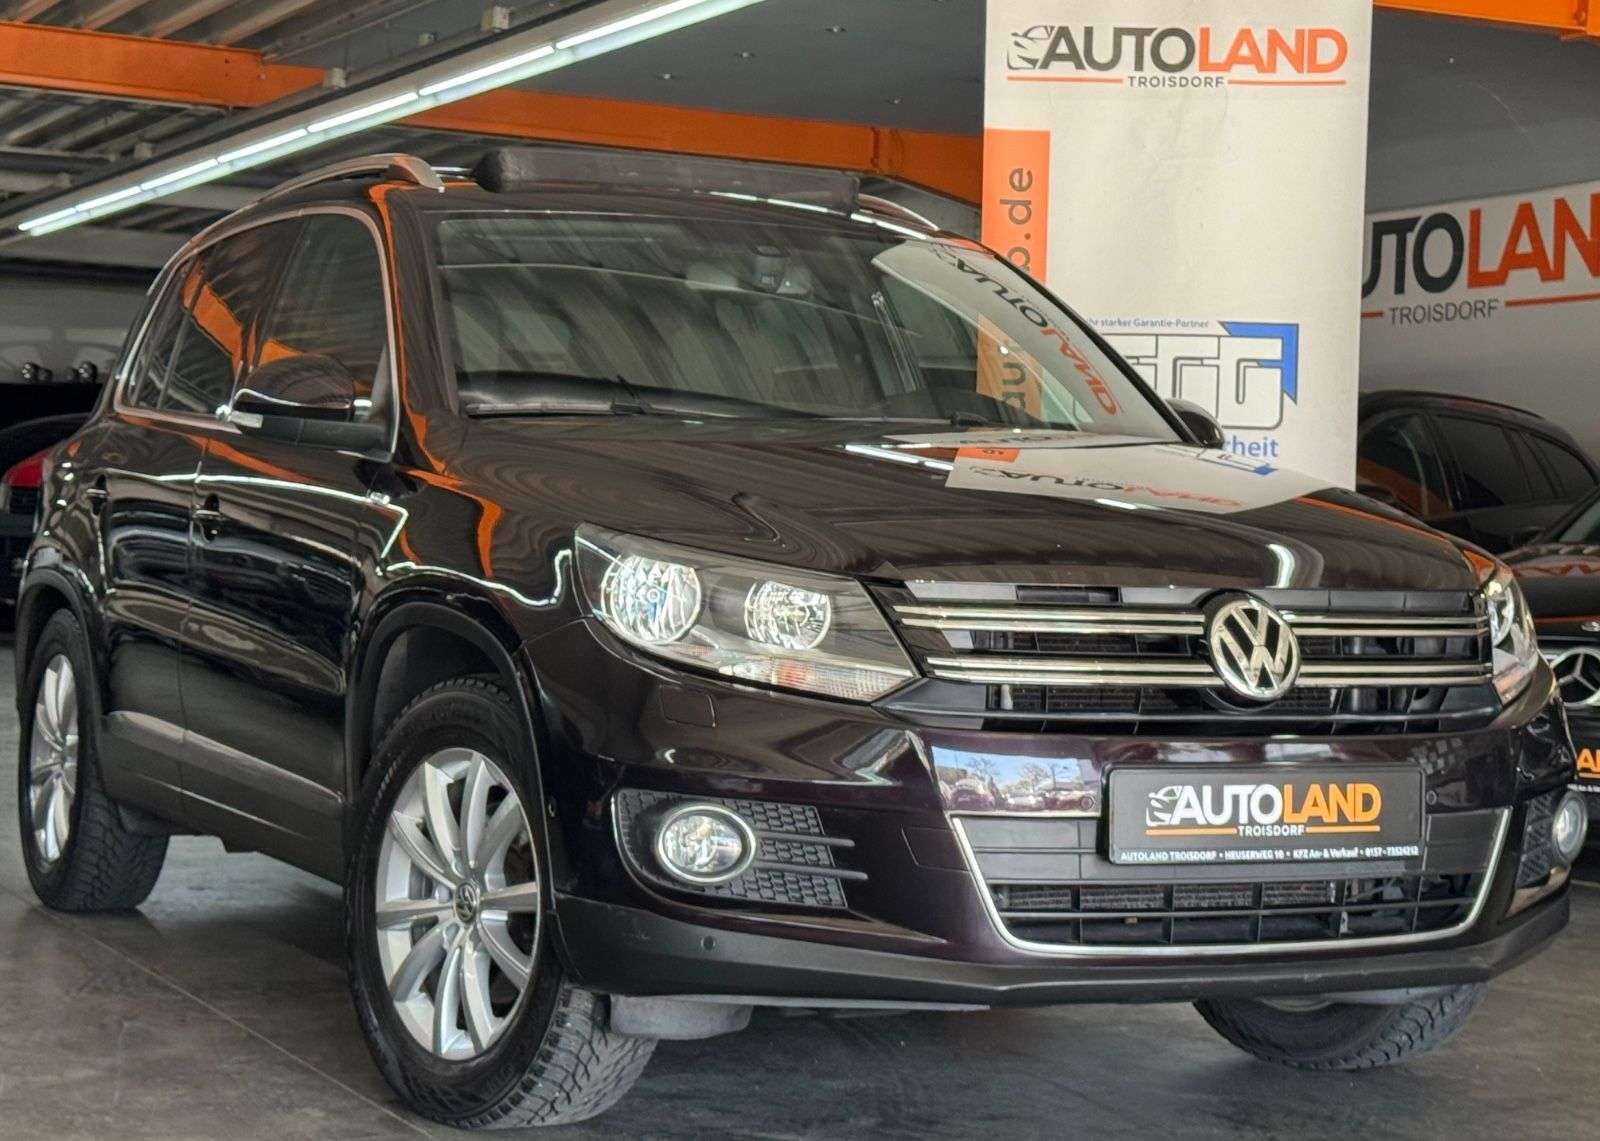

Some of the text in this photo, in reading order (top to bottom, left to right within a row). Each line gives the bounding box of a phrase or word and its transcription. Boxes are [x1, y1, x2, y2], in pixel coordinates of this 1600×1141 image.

[1040, 26, 1348, 74] AUTOLAND
[1127, 75, 1224, 89] TROISDORF
[1388, 297, 1499, 326] TROISDORF
[1170, 783, 1382, 826] AUTOLAND
[1237, 825, 1306, 837] TROISDORF
[1120, 851, 1165, 862] AUTOLAND
[1169, 850, 1217, 861] TROISDORF
